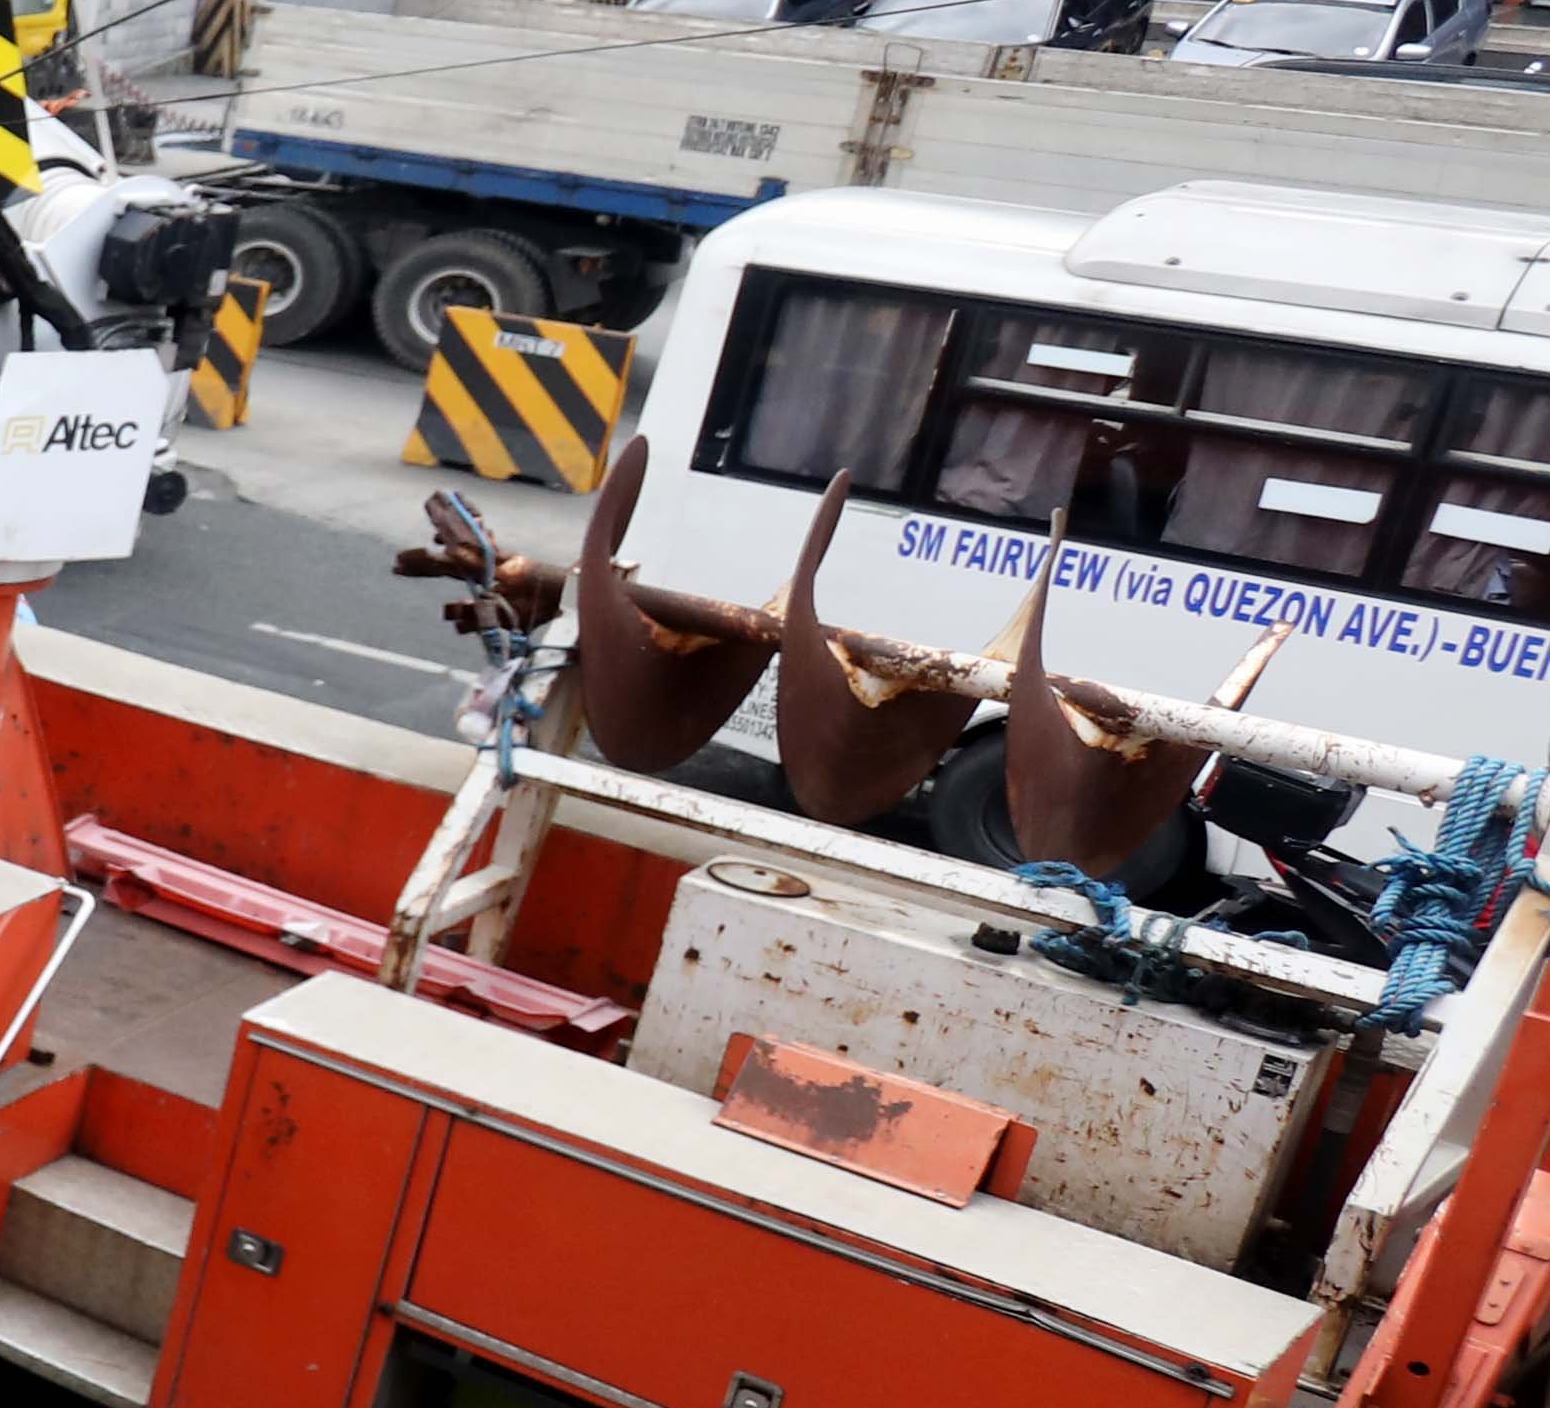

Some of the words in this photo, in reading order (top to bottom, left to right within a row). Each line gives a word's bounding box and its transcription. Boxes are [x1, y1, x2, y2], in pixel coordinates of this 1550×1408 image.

[42, 414, 138, 452] Altec
[898, 520, 947, 564] SM
[950, 528, 1110, 595] FAIRVEW
[1114, 561, 1171, 608] (via
[1183, 572, 1335, 638] QUEZON
[1340, 603, 1441, 663] AVE.)
